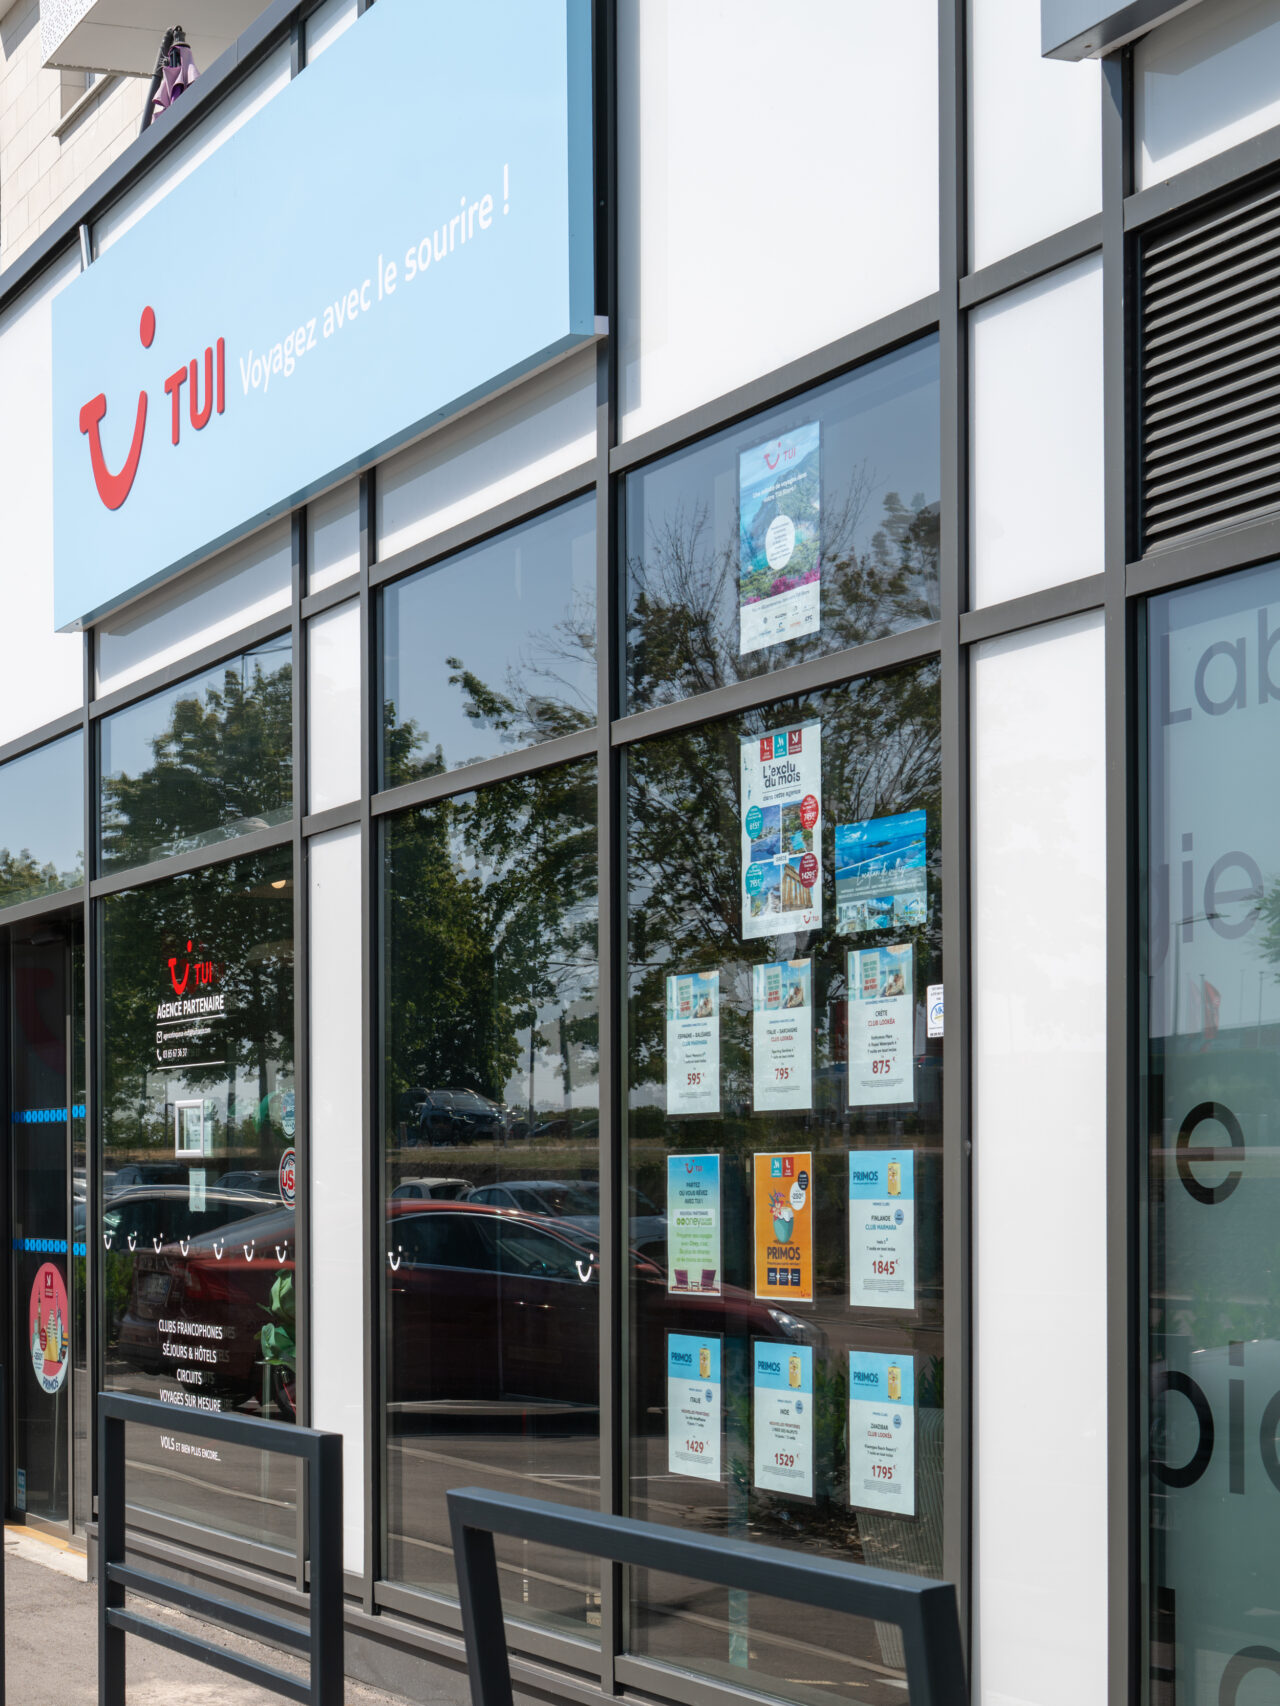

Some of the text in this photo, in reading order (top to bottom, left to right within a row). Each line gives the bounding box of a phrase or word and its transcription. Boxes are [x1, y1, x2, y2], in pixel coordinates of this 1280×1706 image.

[164, 163, 511, 446] TUI Voyagez avec le sourire !
[784, 447, 796, 461] TUI
[763, 760, 797, 779] L'exclu
[764, 771, 801, 789] du mois
[194, 961, 213, 985] TUI
[157, 994, 225, 1020] AGENCE PARTENAIRE
[775, 1068, 789, 1080] 795
[872, 1060, 891, 1074] 875
[687, 1072, 701, 1086] 595
[282, 1169, 296, 1191] US
[853, 1171, 879, 1182] PRIMOS
[767, 1246, 801, 1260] PRIMOS
[872, 1260, 896, 1275] 1845
[159, 1319, 223, 1340] CLUBS FRANCOPHONES
[163, 1340, 217, 1363] SÉJOURS & HÔTELS
[671, 1351, 693, 1364] PRIMOS
[758, 1360, 781, 1373] PRIMOS
[42, 1375, 60, 1391] PRIMOS
[176, 1368, 202, 1385] CIRCUITS
[853, 1371, 879, 1383] PRIMOS
[159, 1388, 222, 1413] VOYAGES SUR MESURE
[160, 1435, 175, 1452] VOLS
[175, 1442, 181, 1453] ET
[181, 1443, 191, 1455] BIEN
[191, 1445, 201, 1457] PLUS
[686, 1439, 704, 1454] 1429
[774, 1453, 795, 1467] 1529
[871, 1464, 893, 1479] 1795
